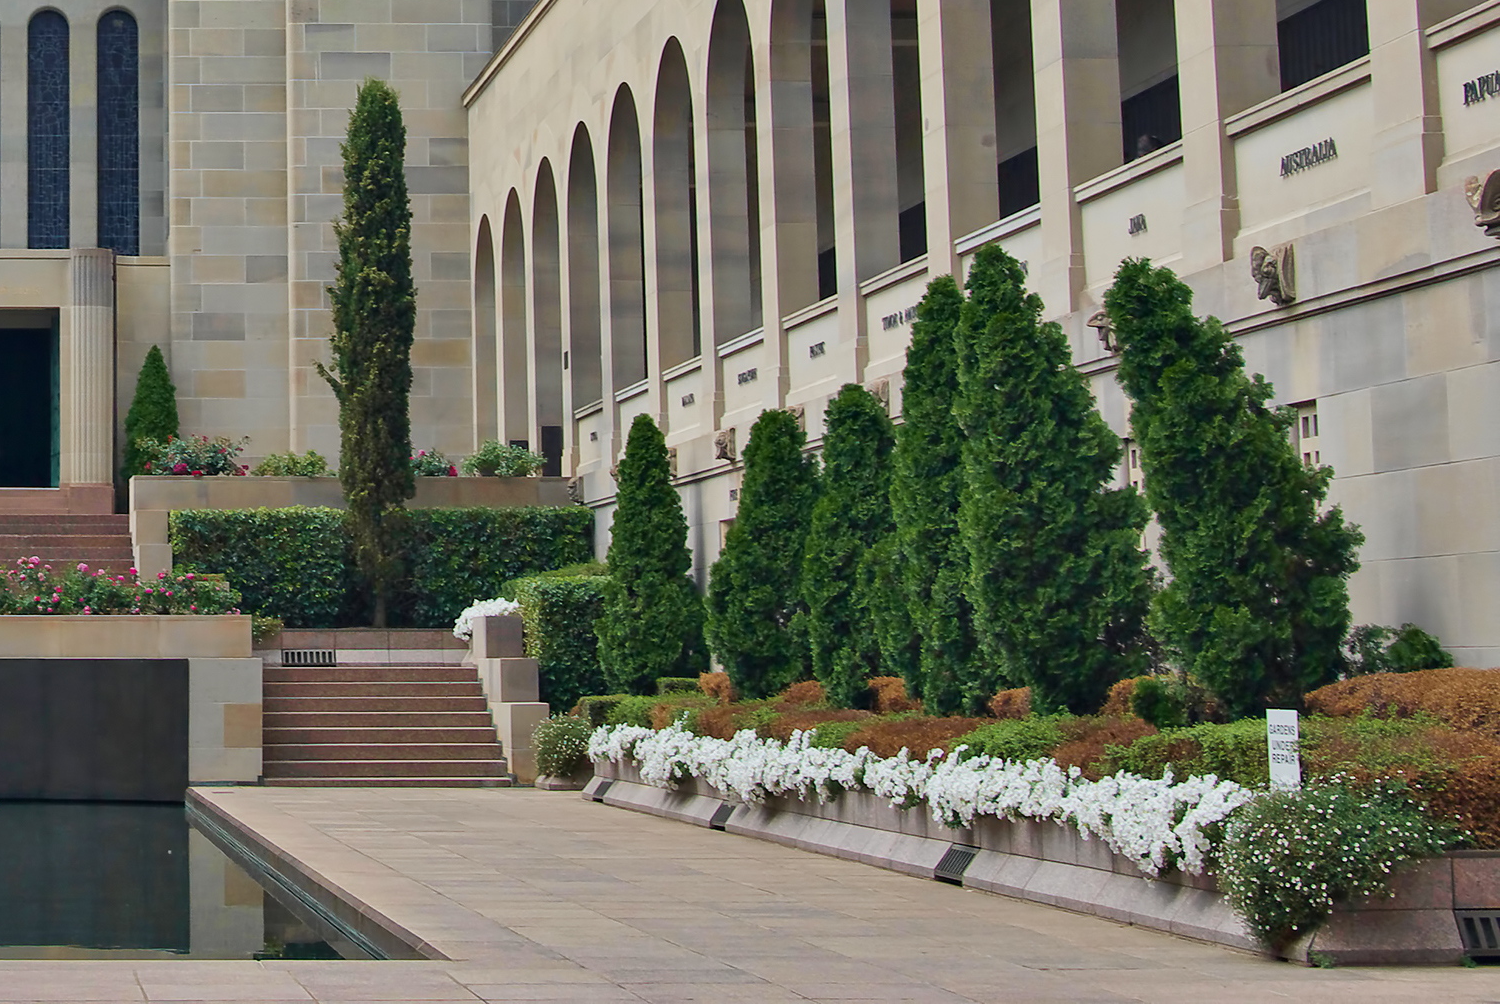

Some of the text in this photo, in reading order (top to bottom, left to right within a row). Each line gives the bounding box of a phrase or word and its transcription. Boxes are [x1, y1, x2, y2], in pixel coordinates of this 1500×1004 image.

[1280, 137, 1338, 178] AUSTRALIA
[1269, 723, 1296, 736] GARDENS
[1272, 753, 1296, 765] REPAIR
